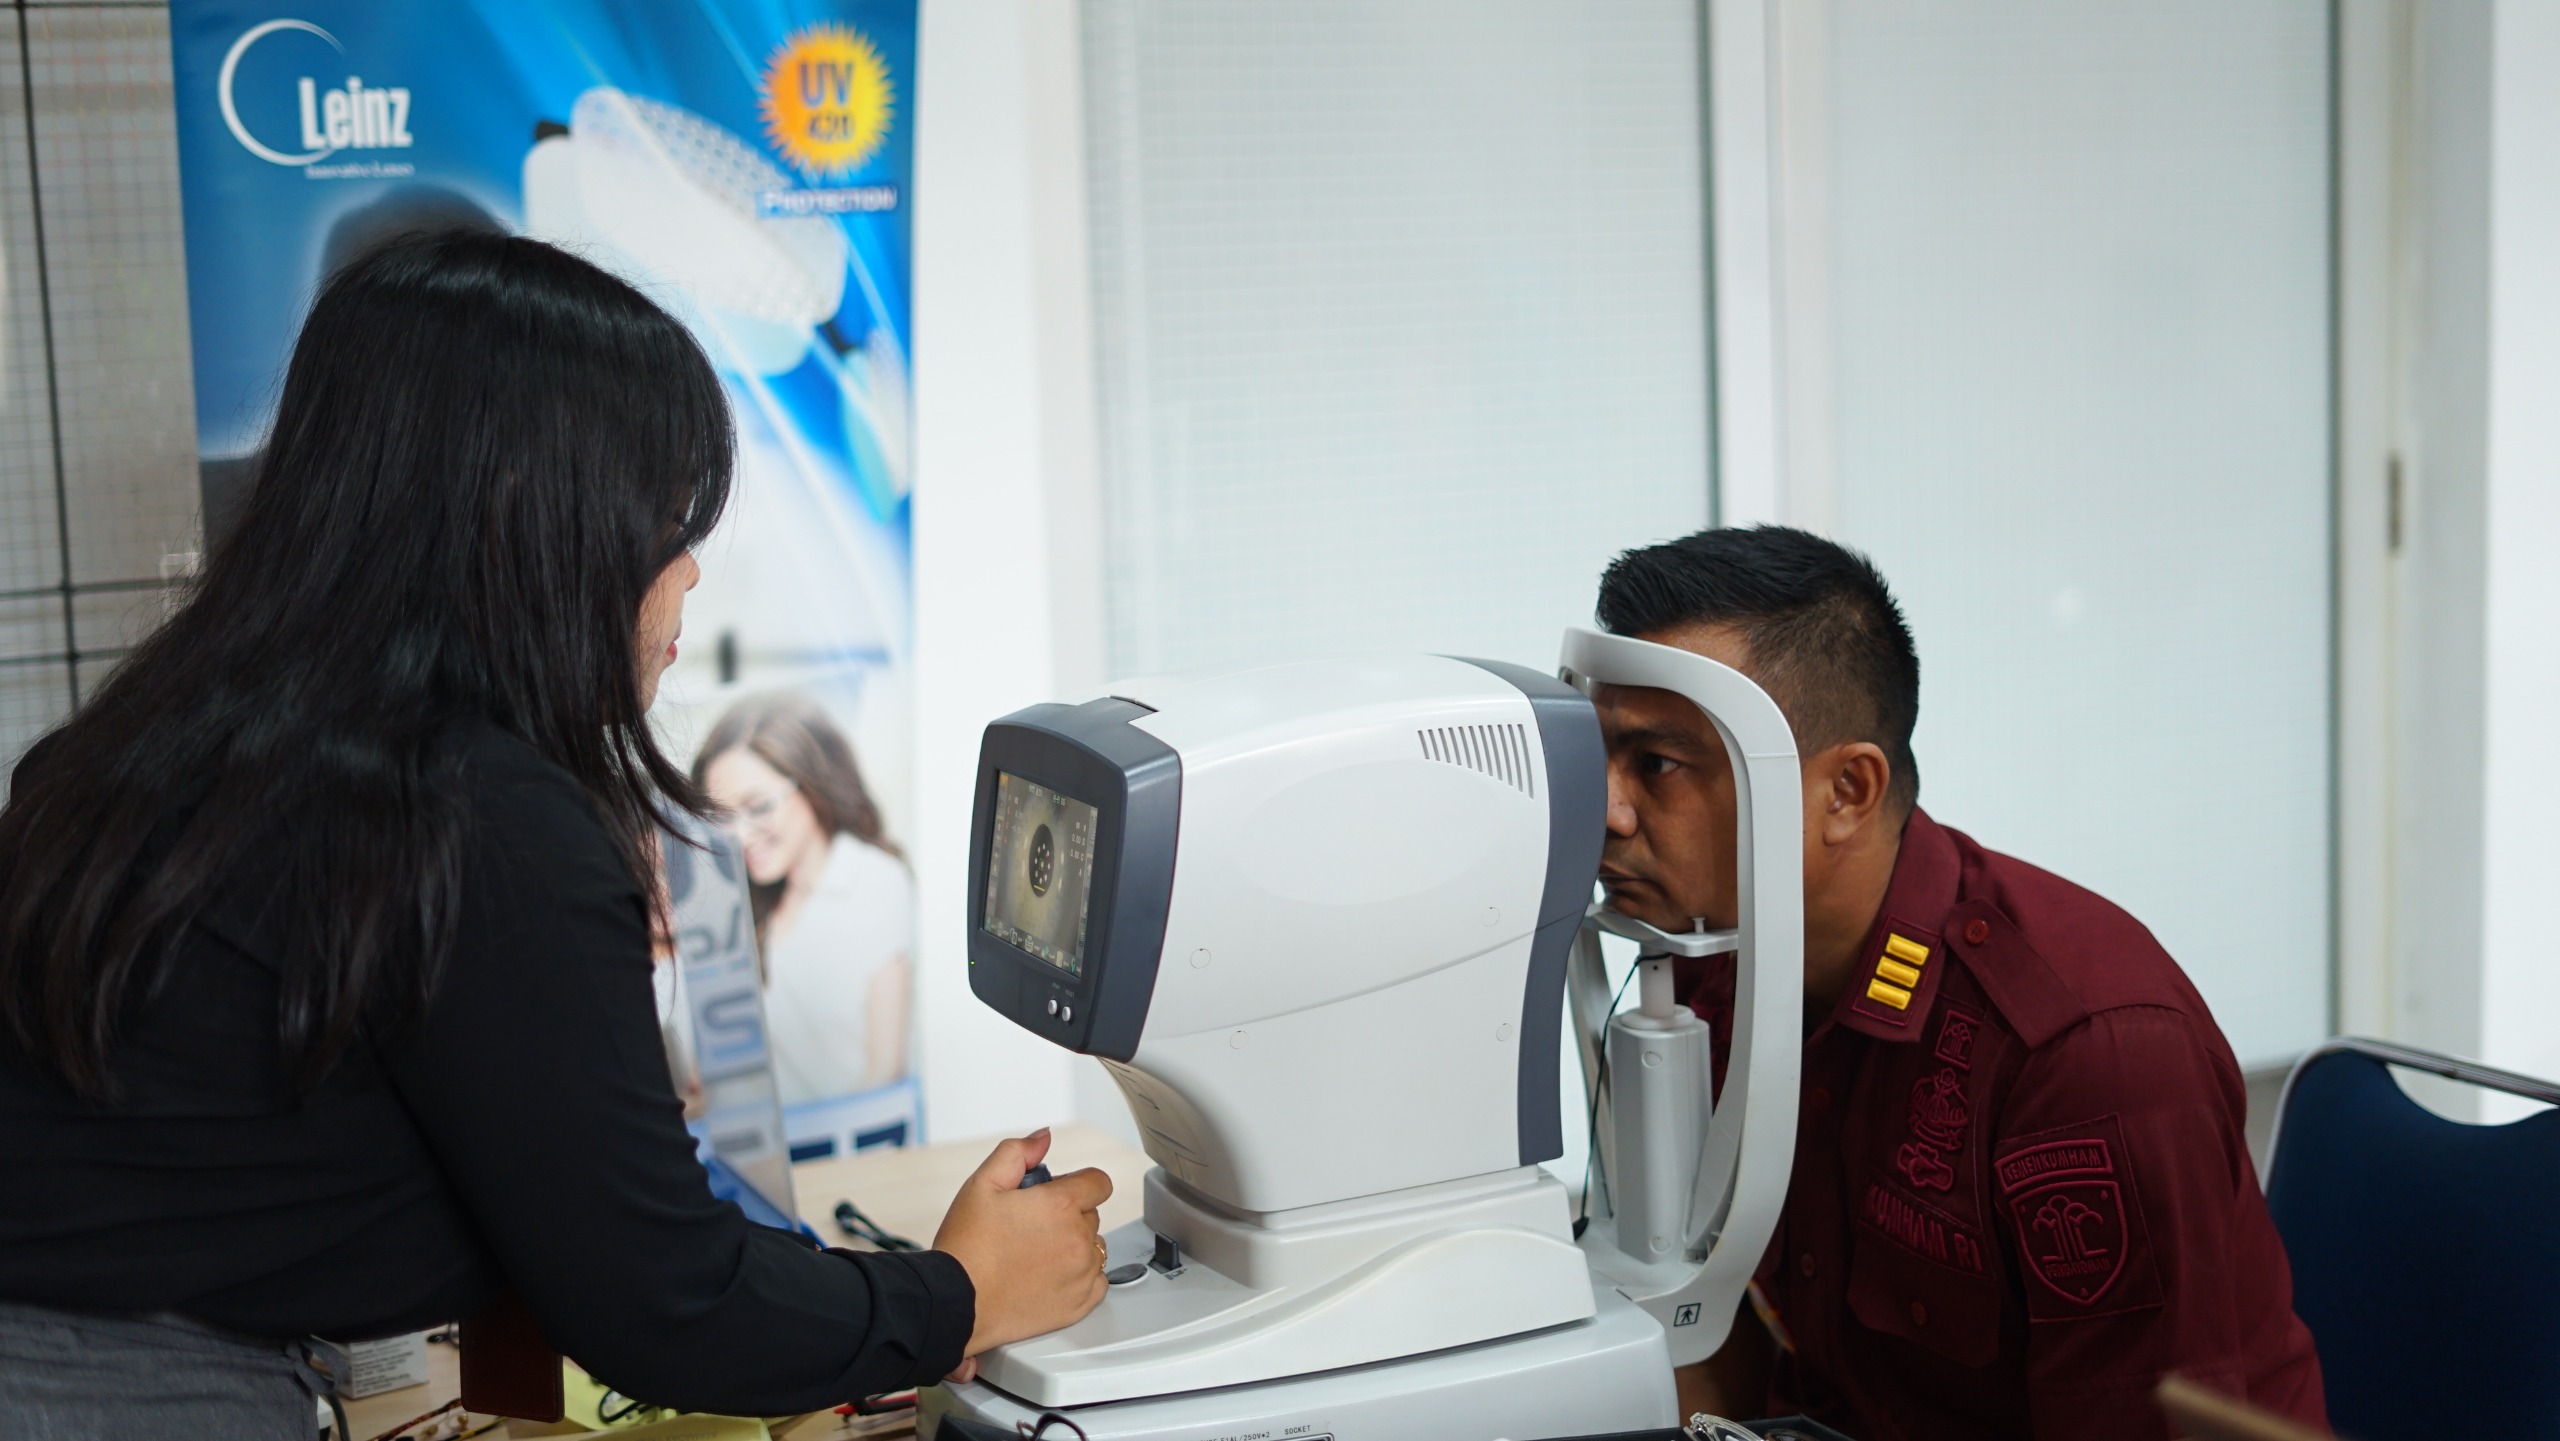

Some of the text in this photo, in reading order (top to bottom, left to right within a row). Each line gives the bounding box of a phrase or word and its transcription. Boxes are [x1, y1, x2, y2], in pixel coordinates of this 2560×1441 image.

[799, 61, 854, 108] UV
[299, 75, 413, 149] Leinz
[1284, 1425, 1311, 1435] SOCKET
